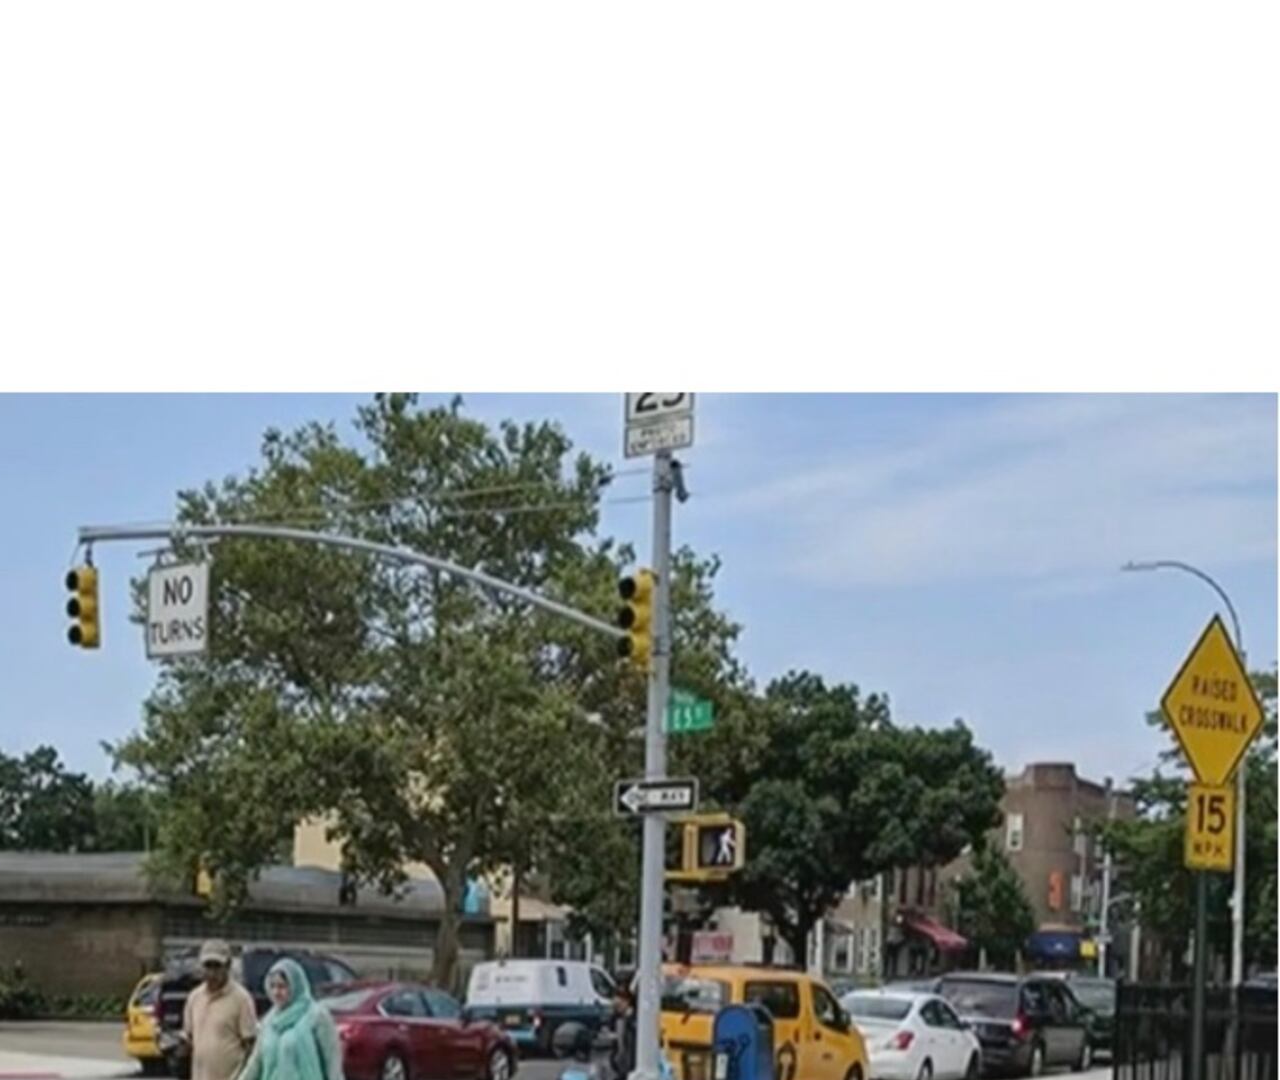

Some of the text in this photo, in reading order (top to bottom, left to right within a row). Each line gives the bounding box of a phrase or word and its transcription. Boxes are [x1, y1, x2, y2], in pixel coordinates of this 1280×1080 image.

[163, 574, 193, 606] NO
[150, 615, 206, 645] TURNS
[1192, 674, 1237, 703] RAISED
[1178, 703, 1248, 735] CROSSWALK
[1197, 794, 1226, 836] 15
